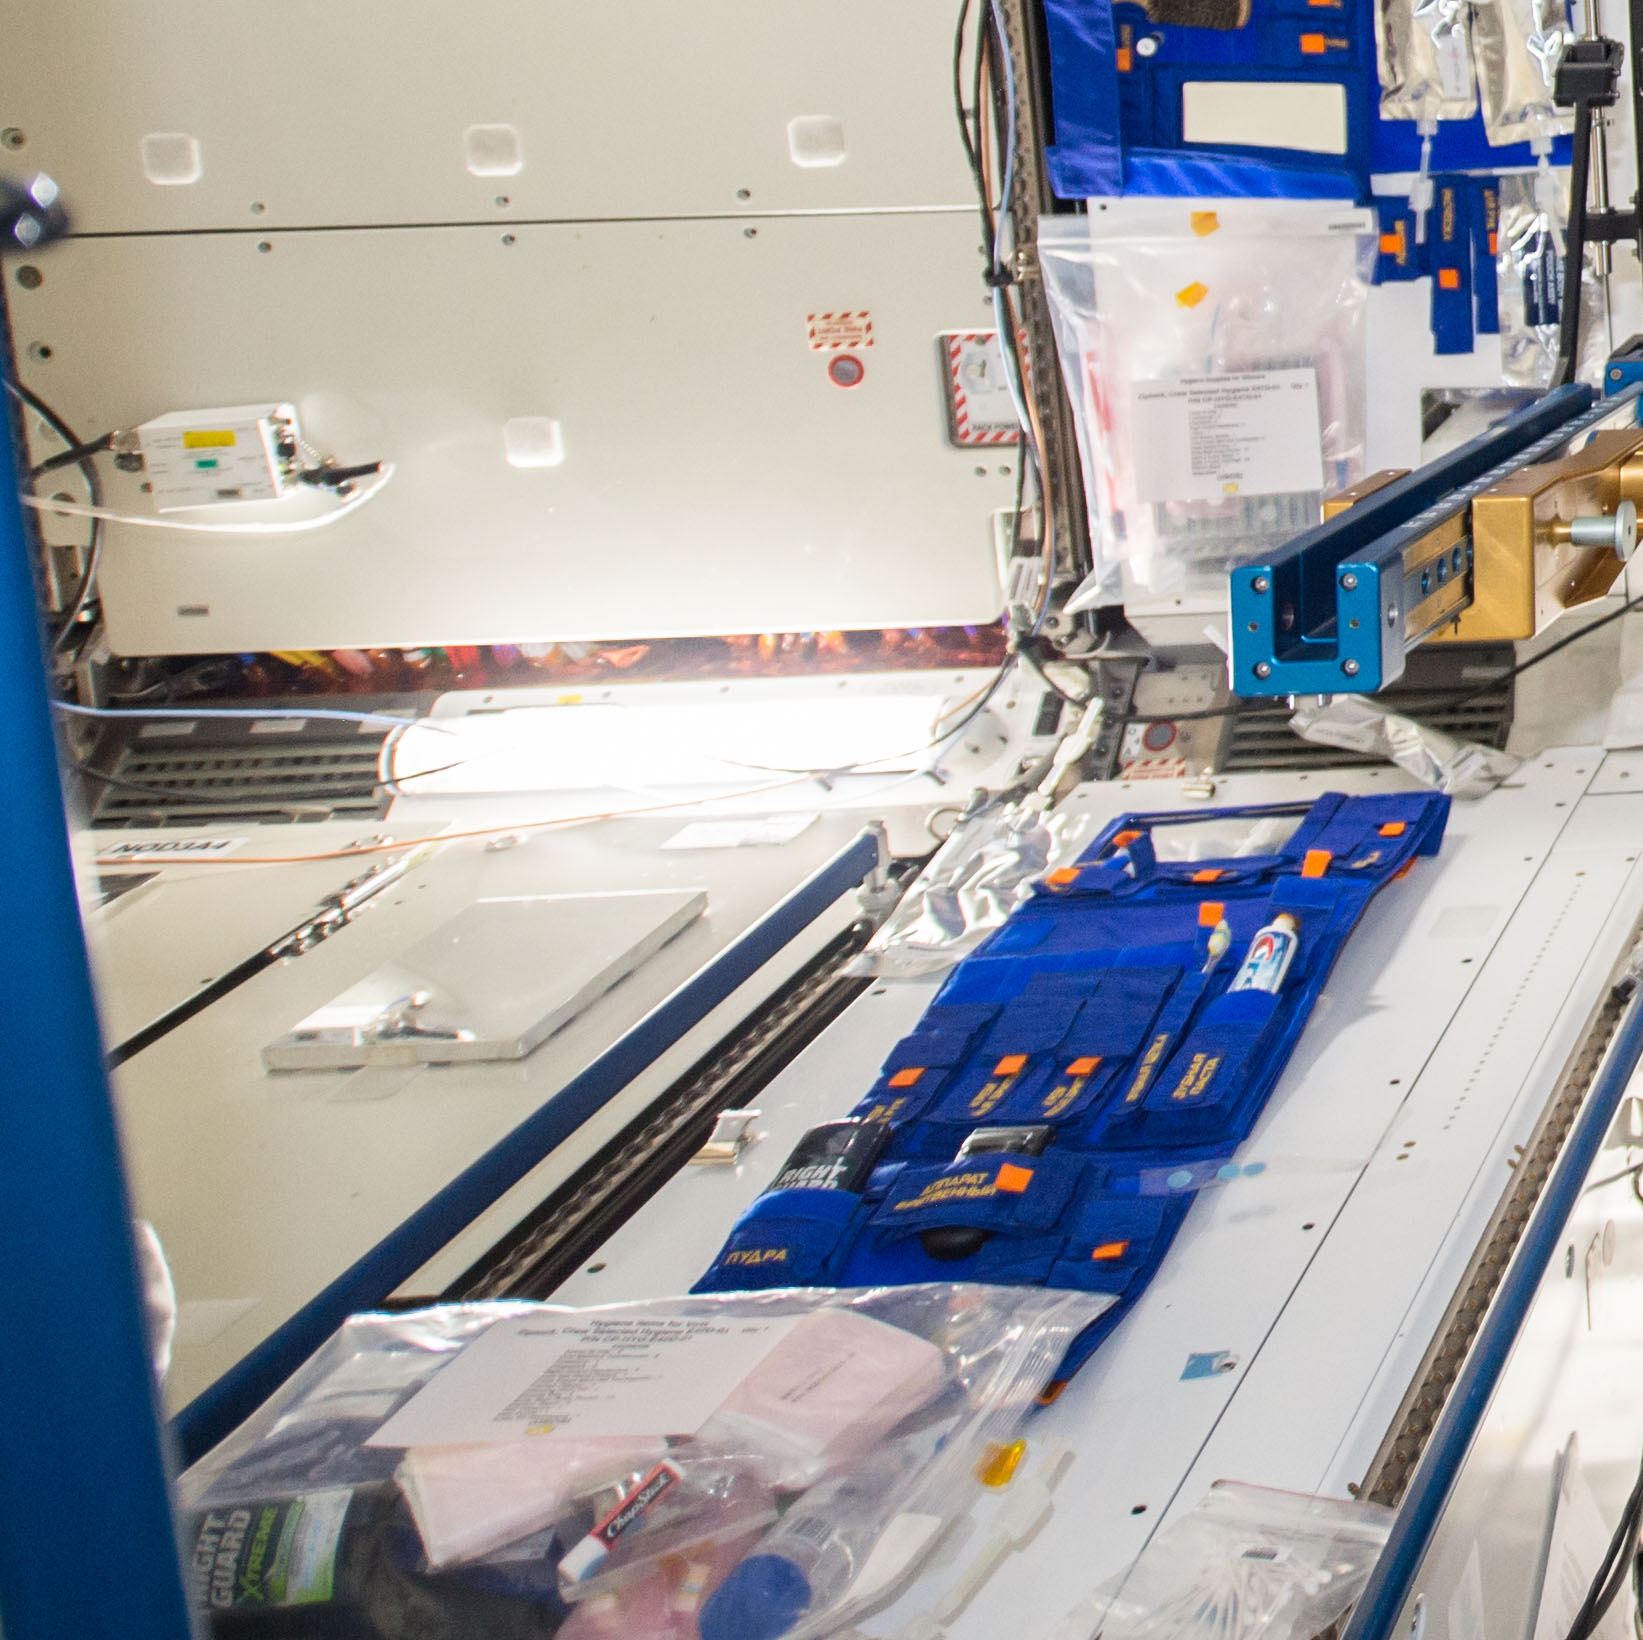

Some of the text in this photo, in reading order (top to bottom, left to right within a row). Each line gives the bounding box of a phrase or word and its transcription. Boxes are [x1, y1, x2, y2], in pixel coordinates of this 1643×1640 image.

[780, 1159, 848, 1188] RIGHT
[725, 1249, 787, 1266] ПУДРА
[209, 1509, 251, 1608] GUARD
